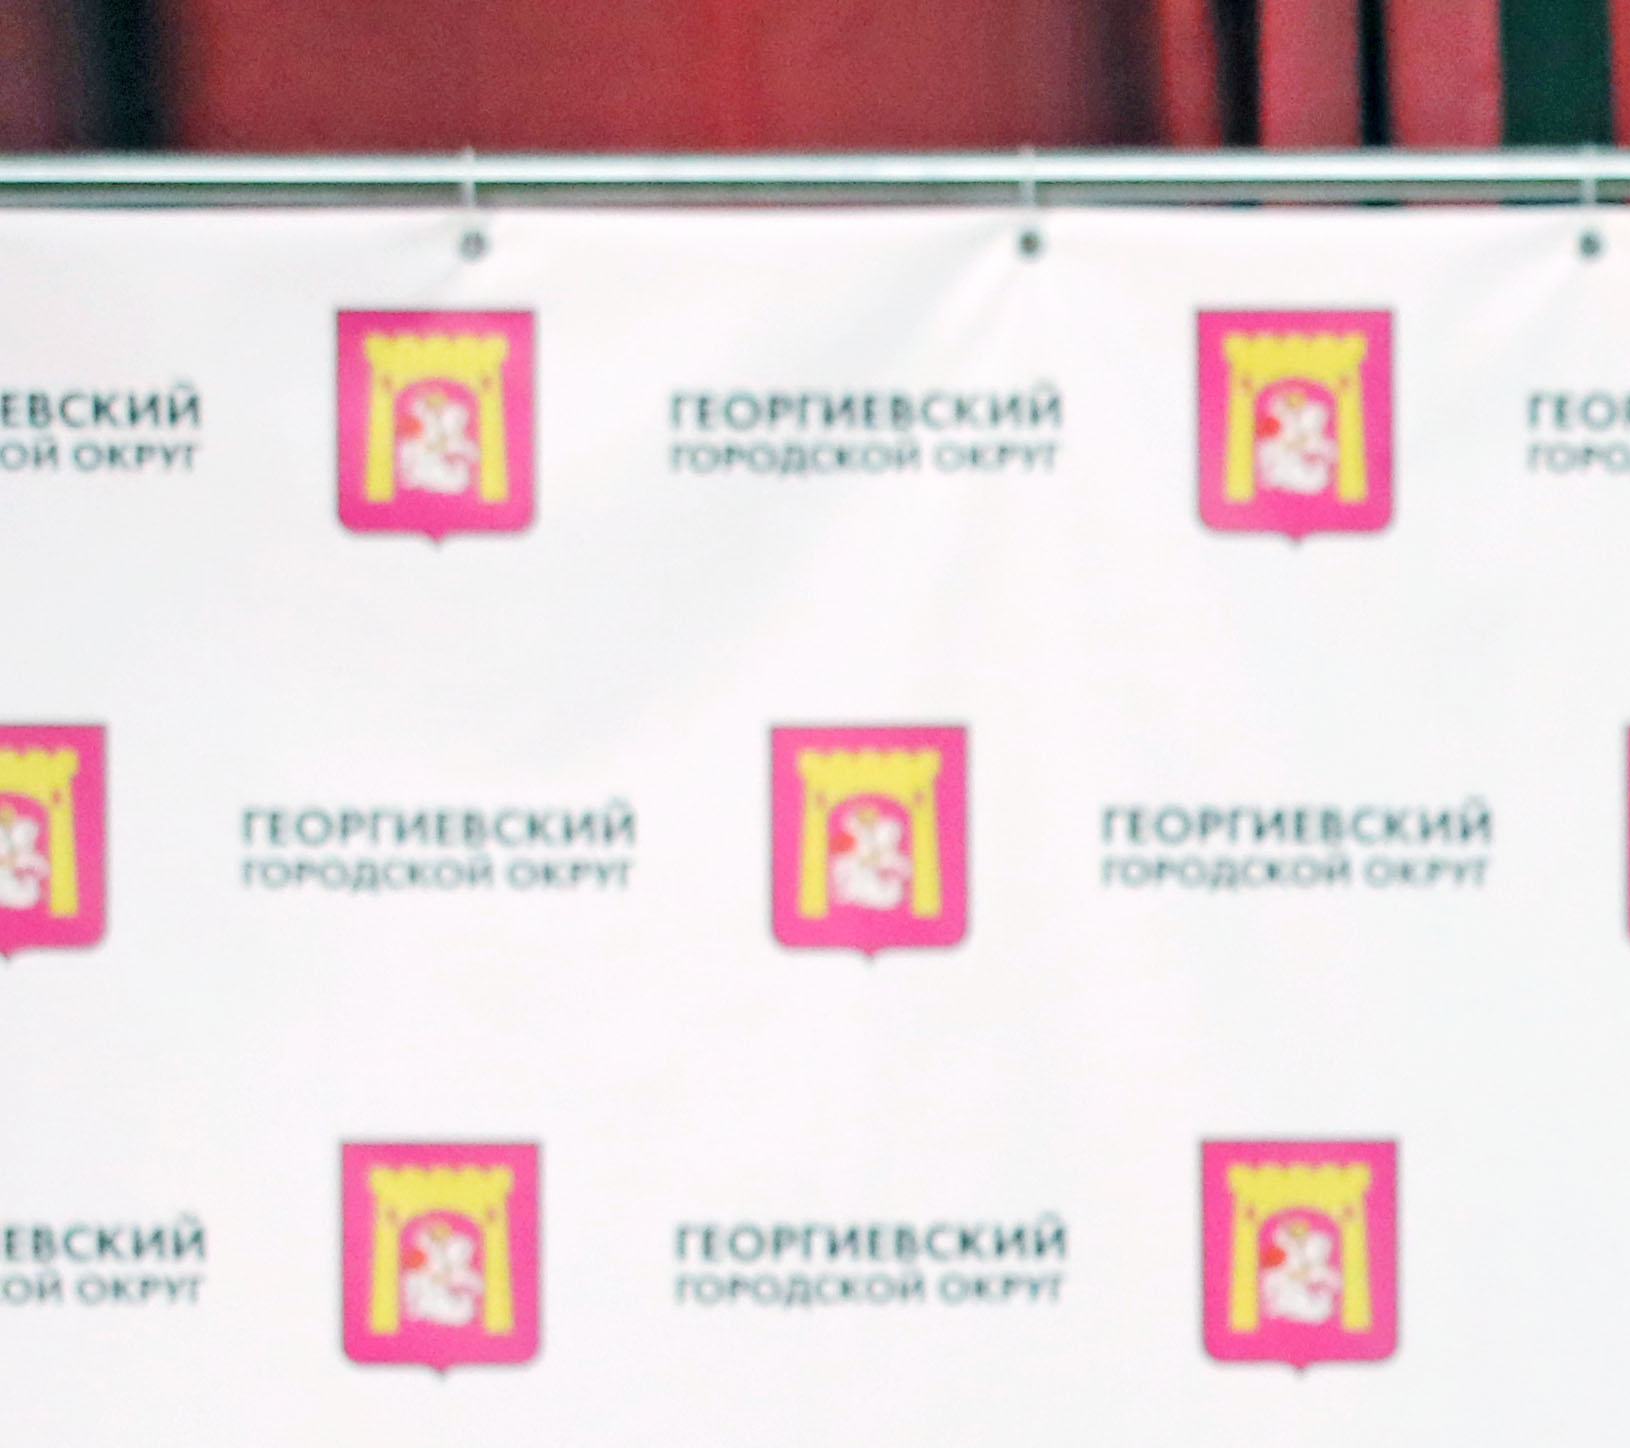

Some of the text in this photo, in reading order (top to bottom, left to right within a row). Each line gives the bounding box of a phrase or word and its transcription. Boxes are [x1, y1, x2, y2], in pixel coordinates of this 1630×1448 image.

[0, 382, 201, 431] ЕВСКИЙ
[670, 384, 1062, 433] ГЕОРГИЕВСКИЙ
[72, 442, 197, 472] ОКРУГ
[671, 440, 1056, 475] ГОРОДСКОЙ ОКРУГ
[242, 801, 636, 849] ГЕОРГИЕВСКИЙ
[1102, 798, 1492, 847] ГЕОРГИЕВСКИЙ
[243, 856, 629, 892] ГОРОДСКОЙ ОКРУГ
[1102, 854, 1486, 890] ГОРОДСКОЙ ОКРУГ
[2, 1215, 206, 1265] ЕВСКИЙ
[675, 1213, 1067, 1264] ГЕОРГИЕВСКИЙ
[76, 1275, 201, 1305] ОКРУГ
[675, 1271, 1062, 1307] ГОРОДСКОЙ ОКРУГ
